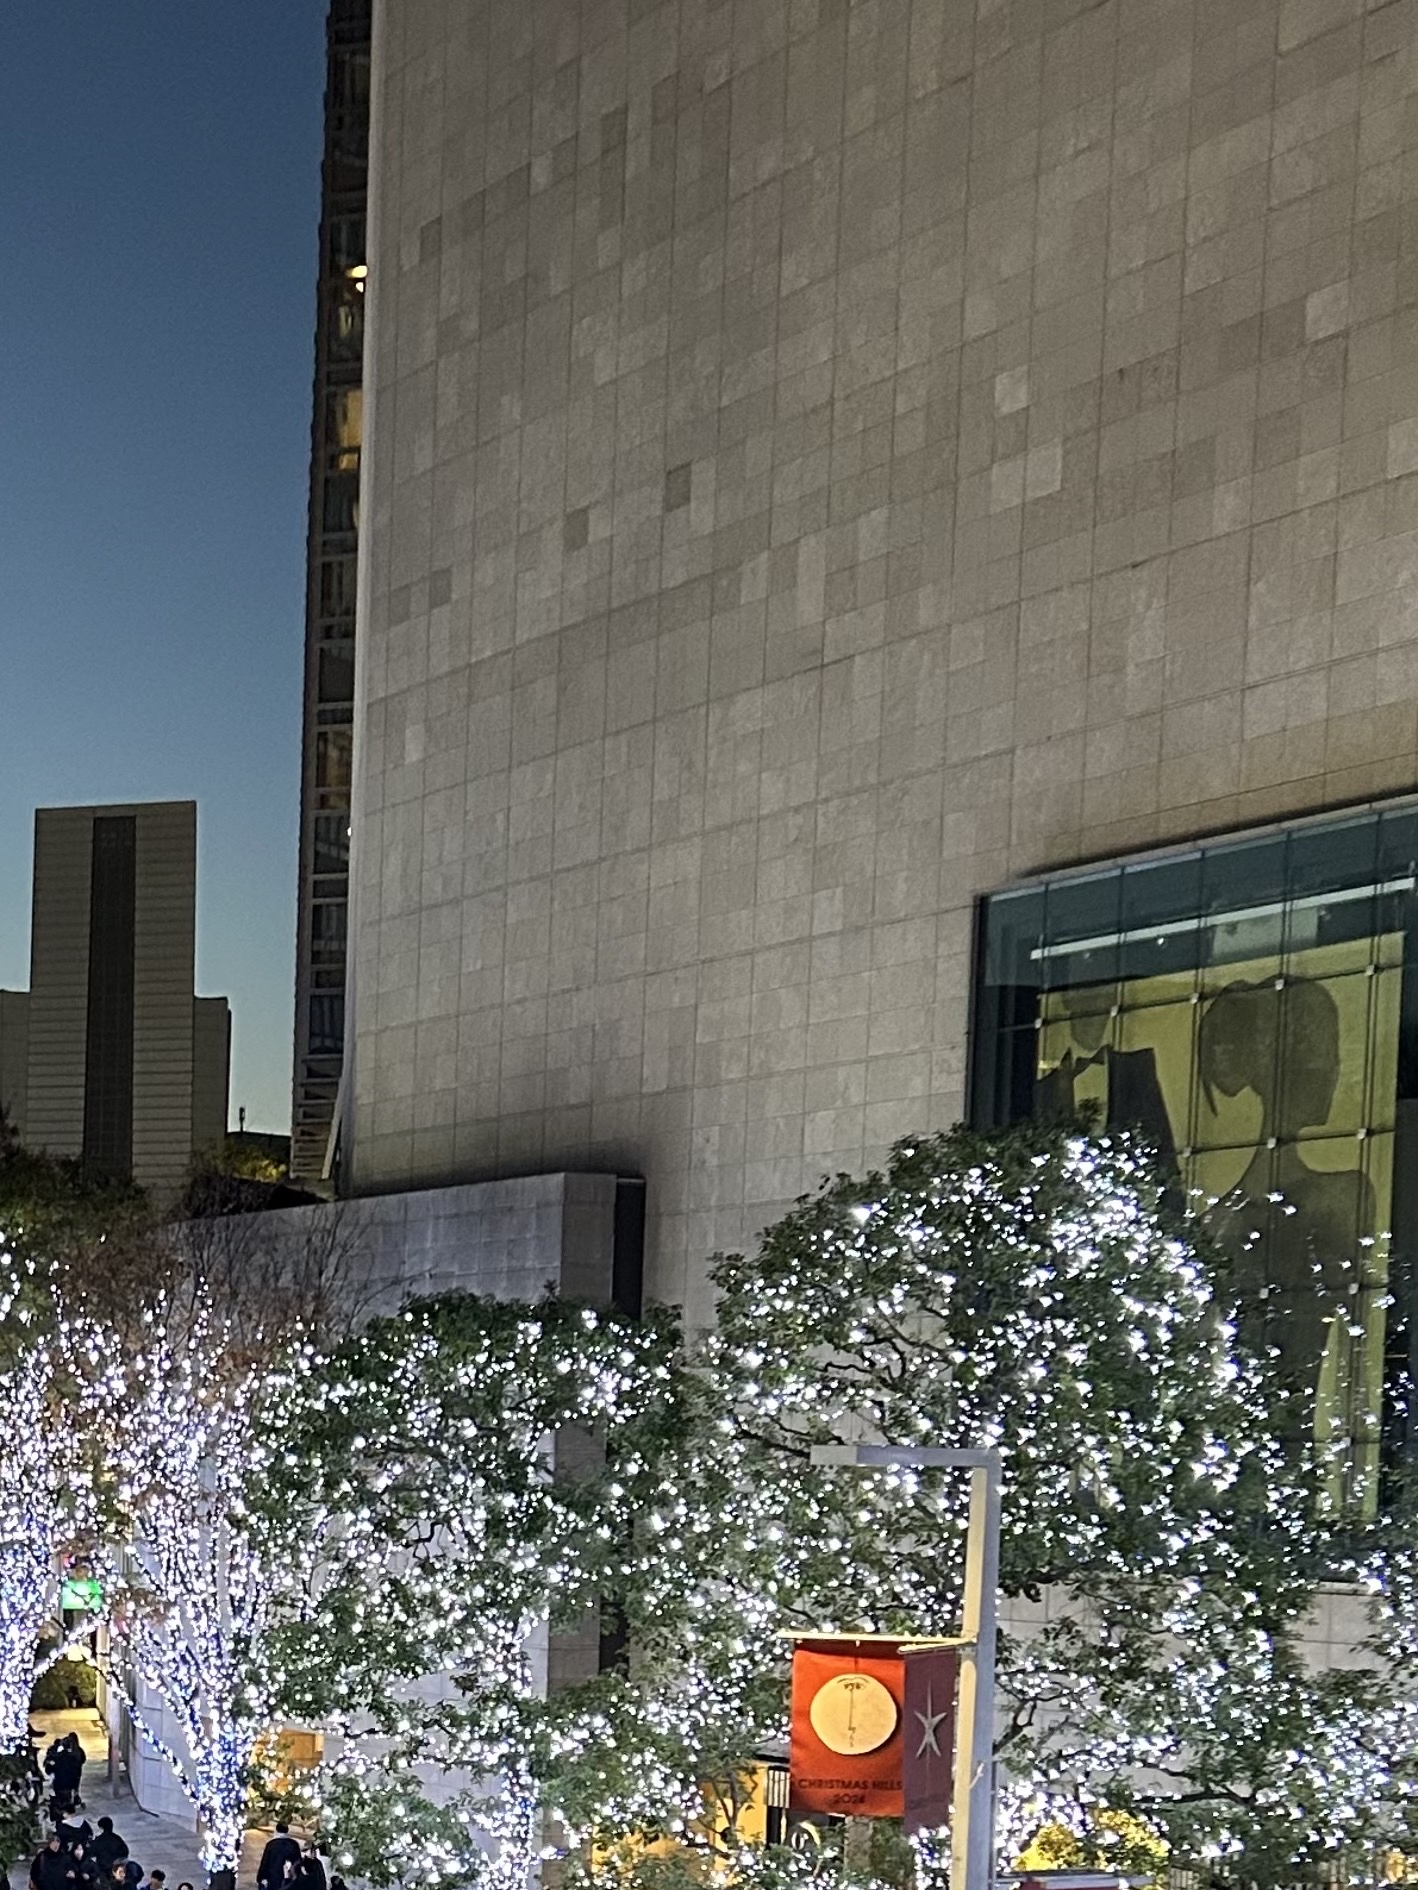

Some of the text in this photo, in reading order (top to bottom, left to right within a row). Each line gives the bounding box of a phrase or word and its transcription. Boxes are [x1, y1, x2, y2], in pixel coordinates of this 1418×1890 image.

[797, 1778, 902, 1791] CHRISTMAS HILLS
[832, 1792, 866, 1804] 2024
